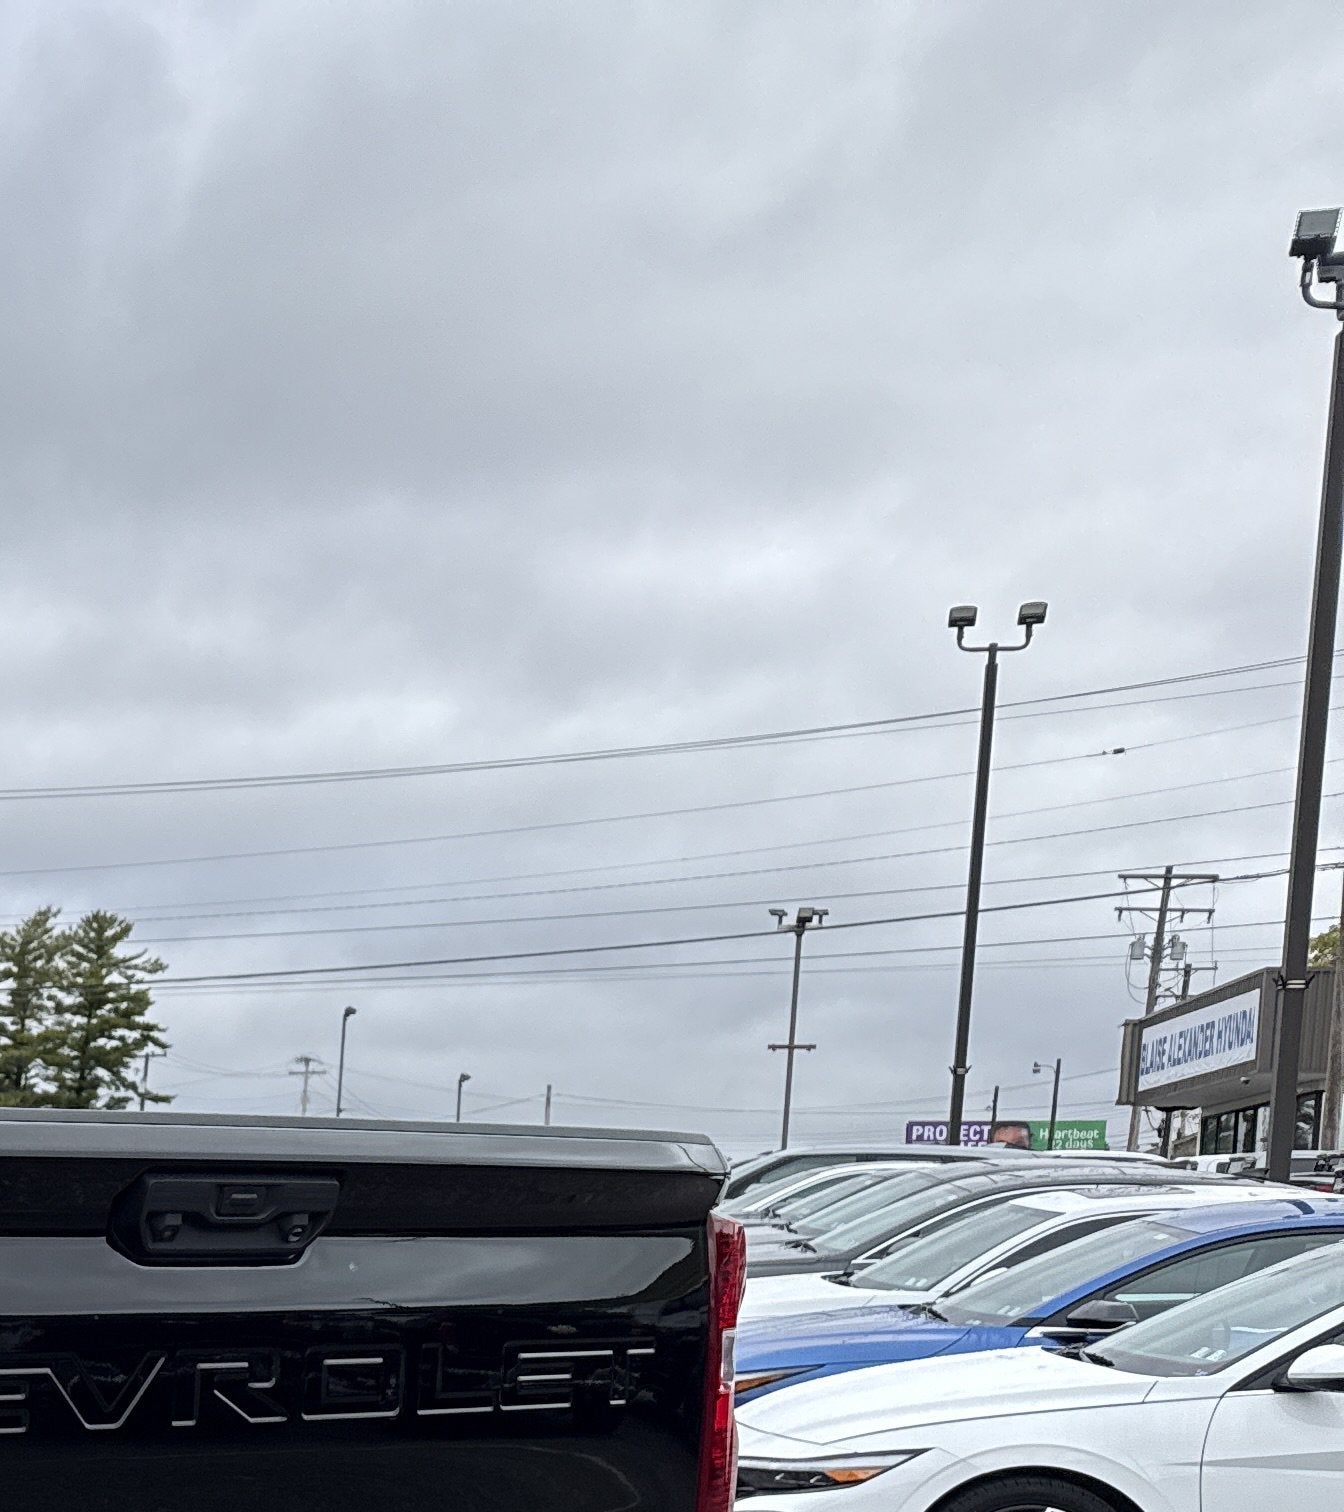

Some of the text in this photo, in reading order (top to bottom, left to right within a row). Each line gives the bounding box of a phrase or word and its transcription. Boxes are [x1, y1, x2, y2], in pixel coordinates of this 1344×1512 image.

[1167, 1019, 1216, 1069] ALEXANDER
[1216, 1007, 1256, 1055] HYUNDAI
[911, 1124, 992, 1141] PROECT
[1039, 1127, 1100, 1140] Hartbeat
